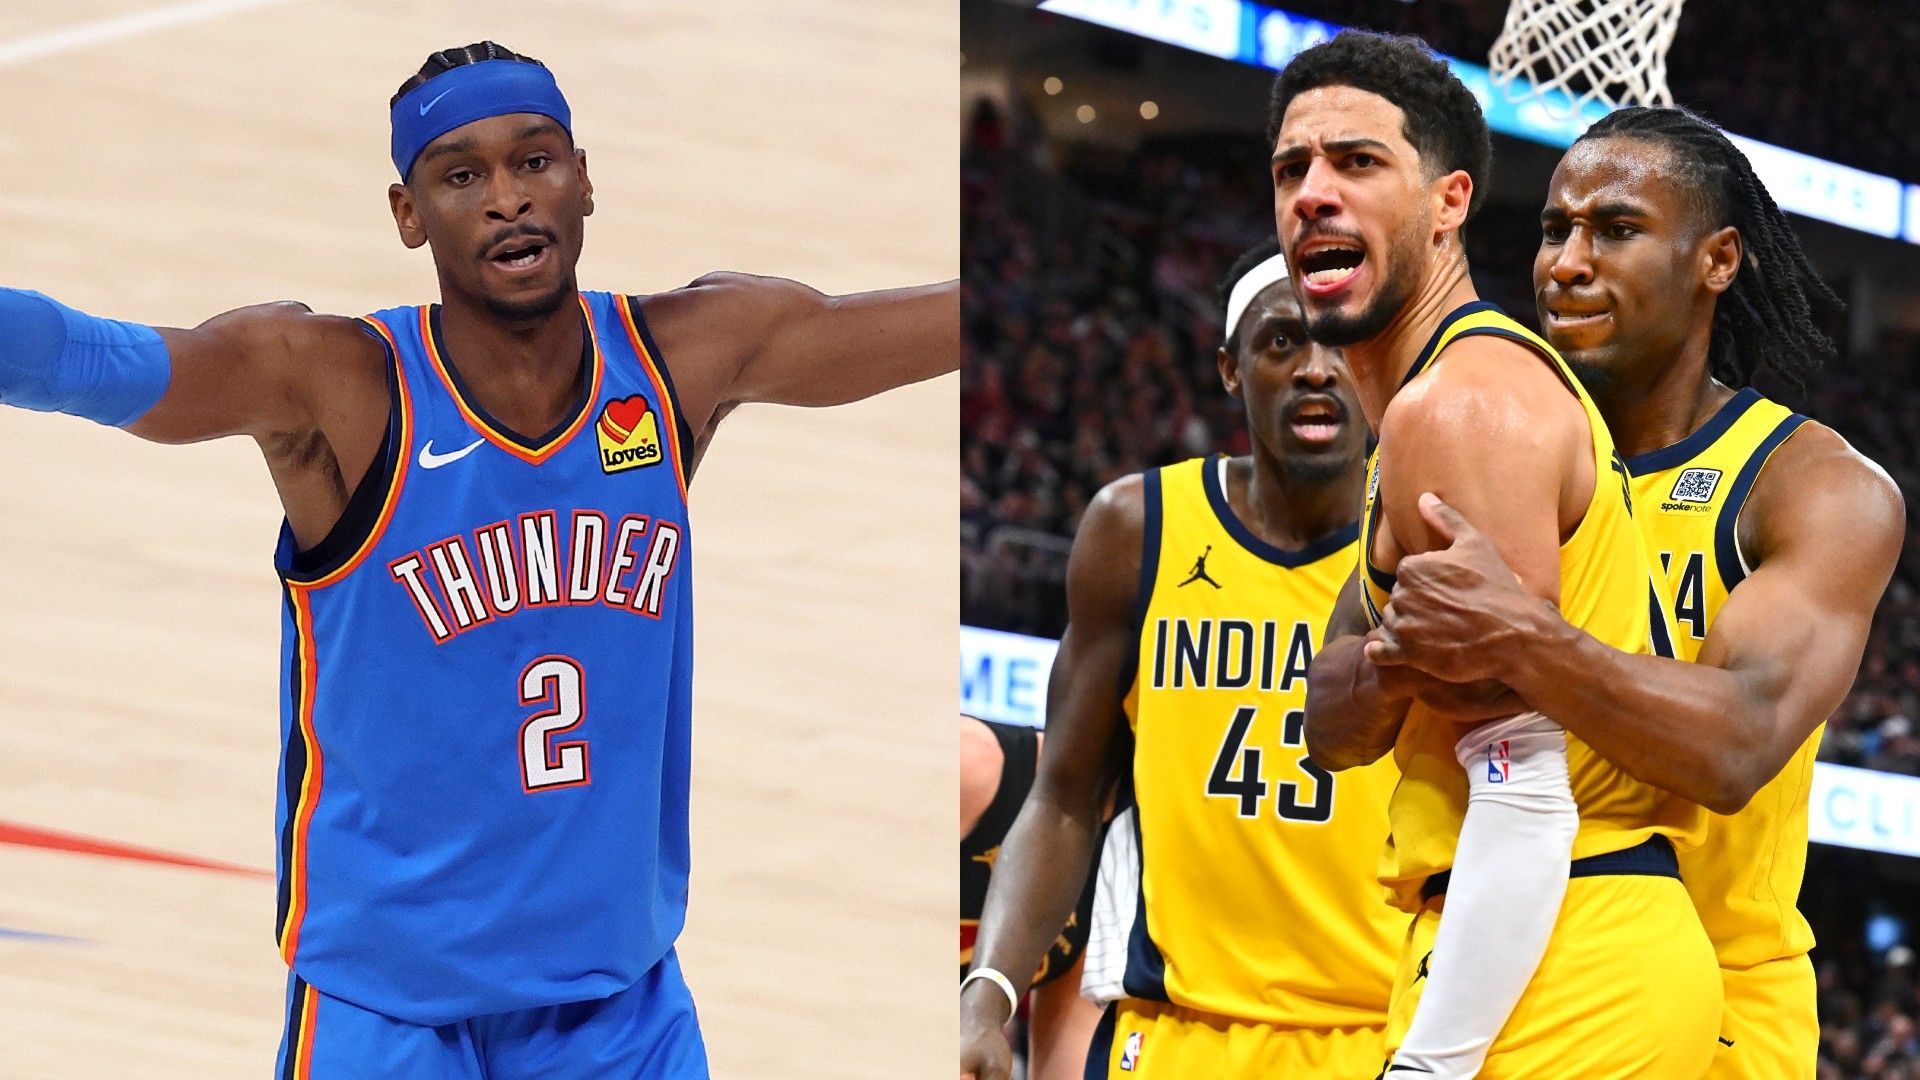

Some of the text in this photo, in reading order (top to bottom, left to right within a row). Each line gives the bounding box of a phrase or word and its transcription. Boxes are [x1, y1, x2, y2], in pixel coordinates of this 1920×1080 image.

[1661, 502, 1711, 513] spokenote
[388, 509, 682, 645] THUNDER
[1152, 617, 1314, 692] INDIA
[517, 654, 591, 794] 2
[1205, 705, 1337, 824] 43
